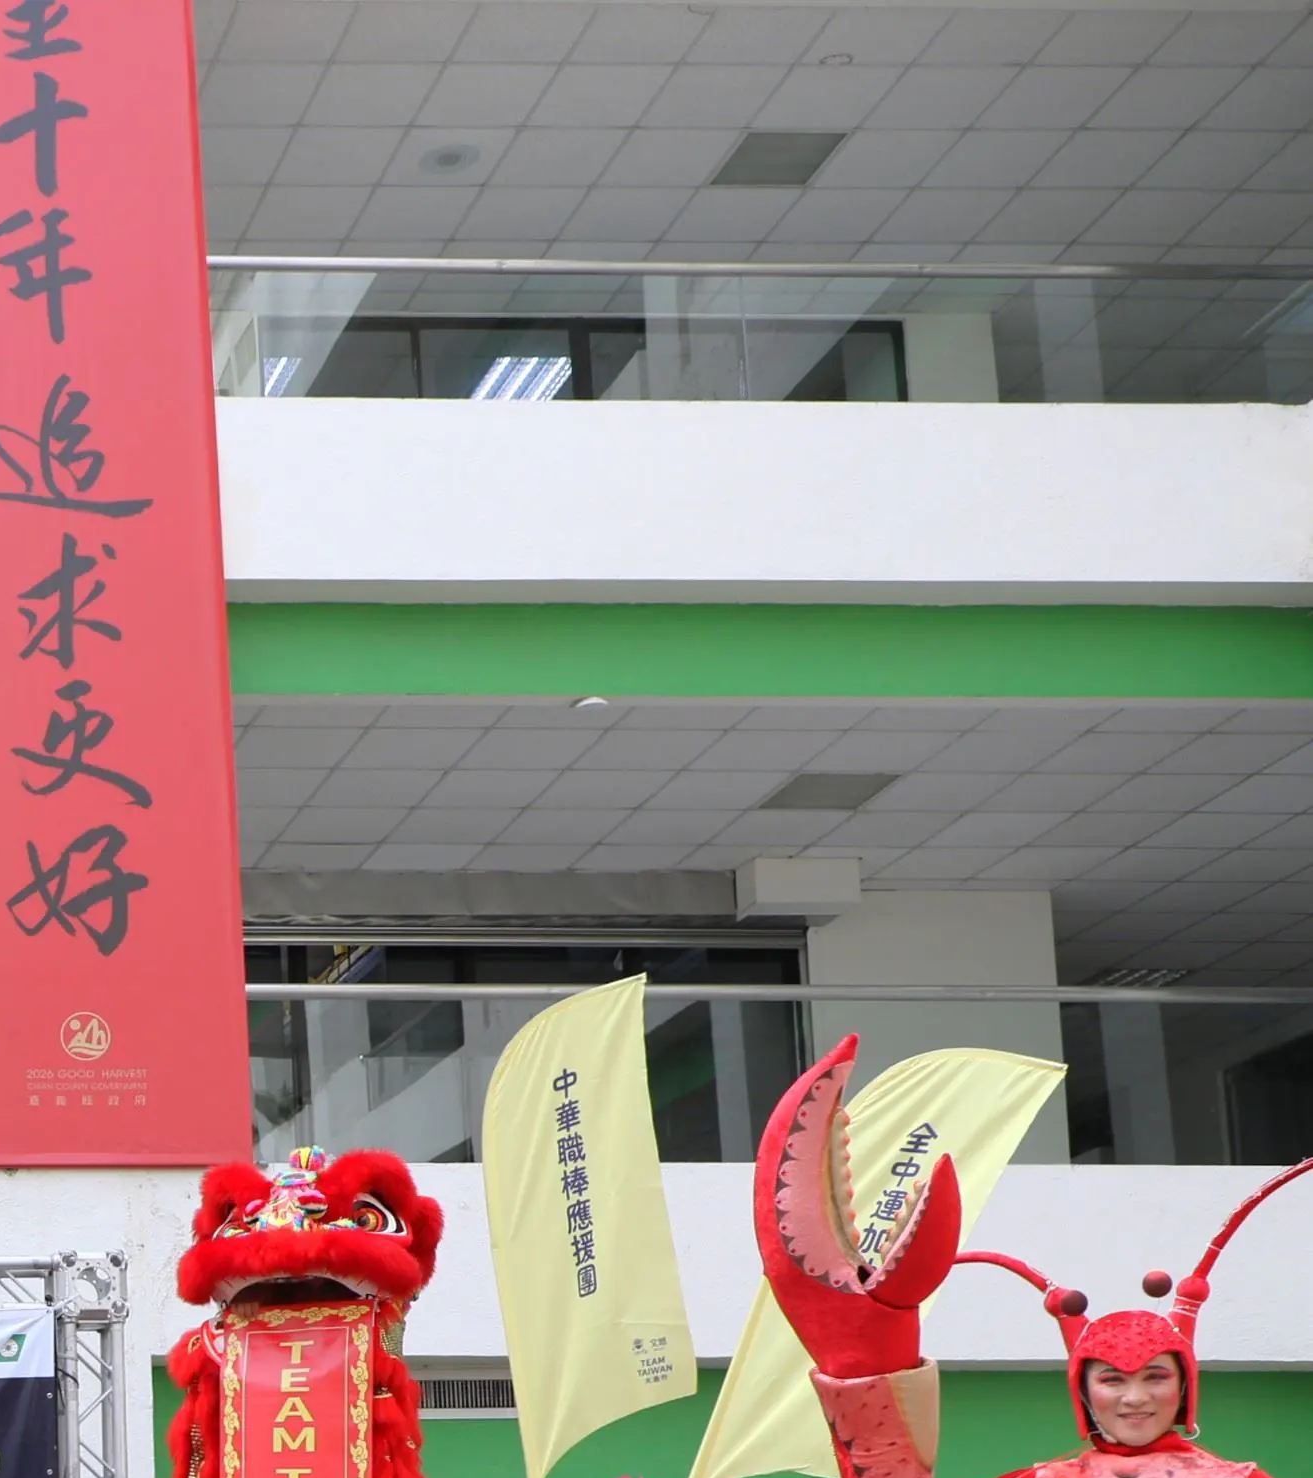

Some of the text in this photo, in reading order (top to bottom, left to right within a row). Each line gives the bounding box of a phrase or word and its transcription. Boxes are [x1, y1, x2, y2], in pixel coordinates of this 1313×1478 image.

[57, 1069, 94, 1079] GOOD
[101, 1069, 148, 1079] HARVEST
[553, 1068, 597, 1298] 中華職棒應援團
[859, 1122, 939, 1270] 全中運加
[273, 1340, 316, 1453] TEAM
